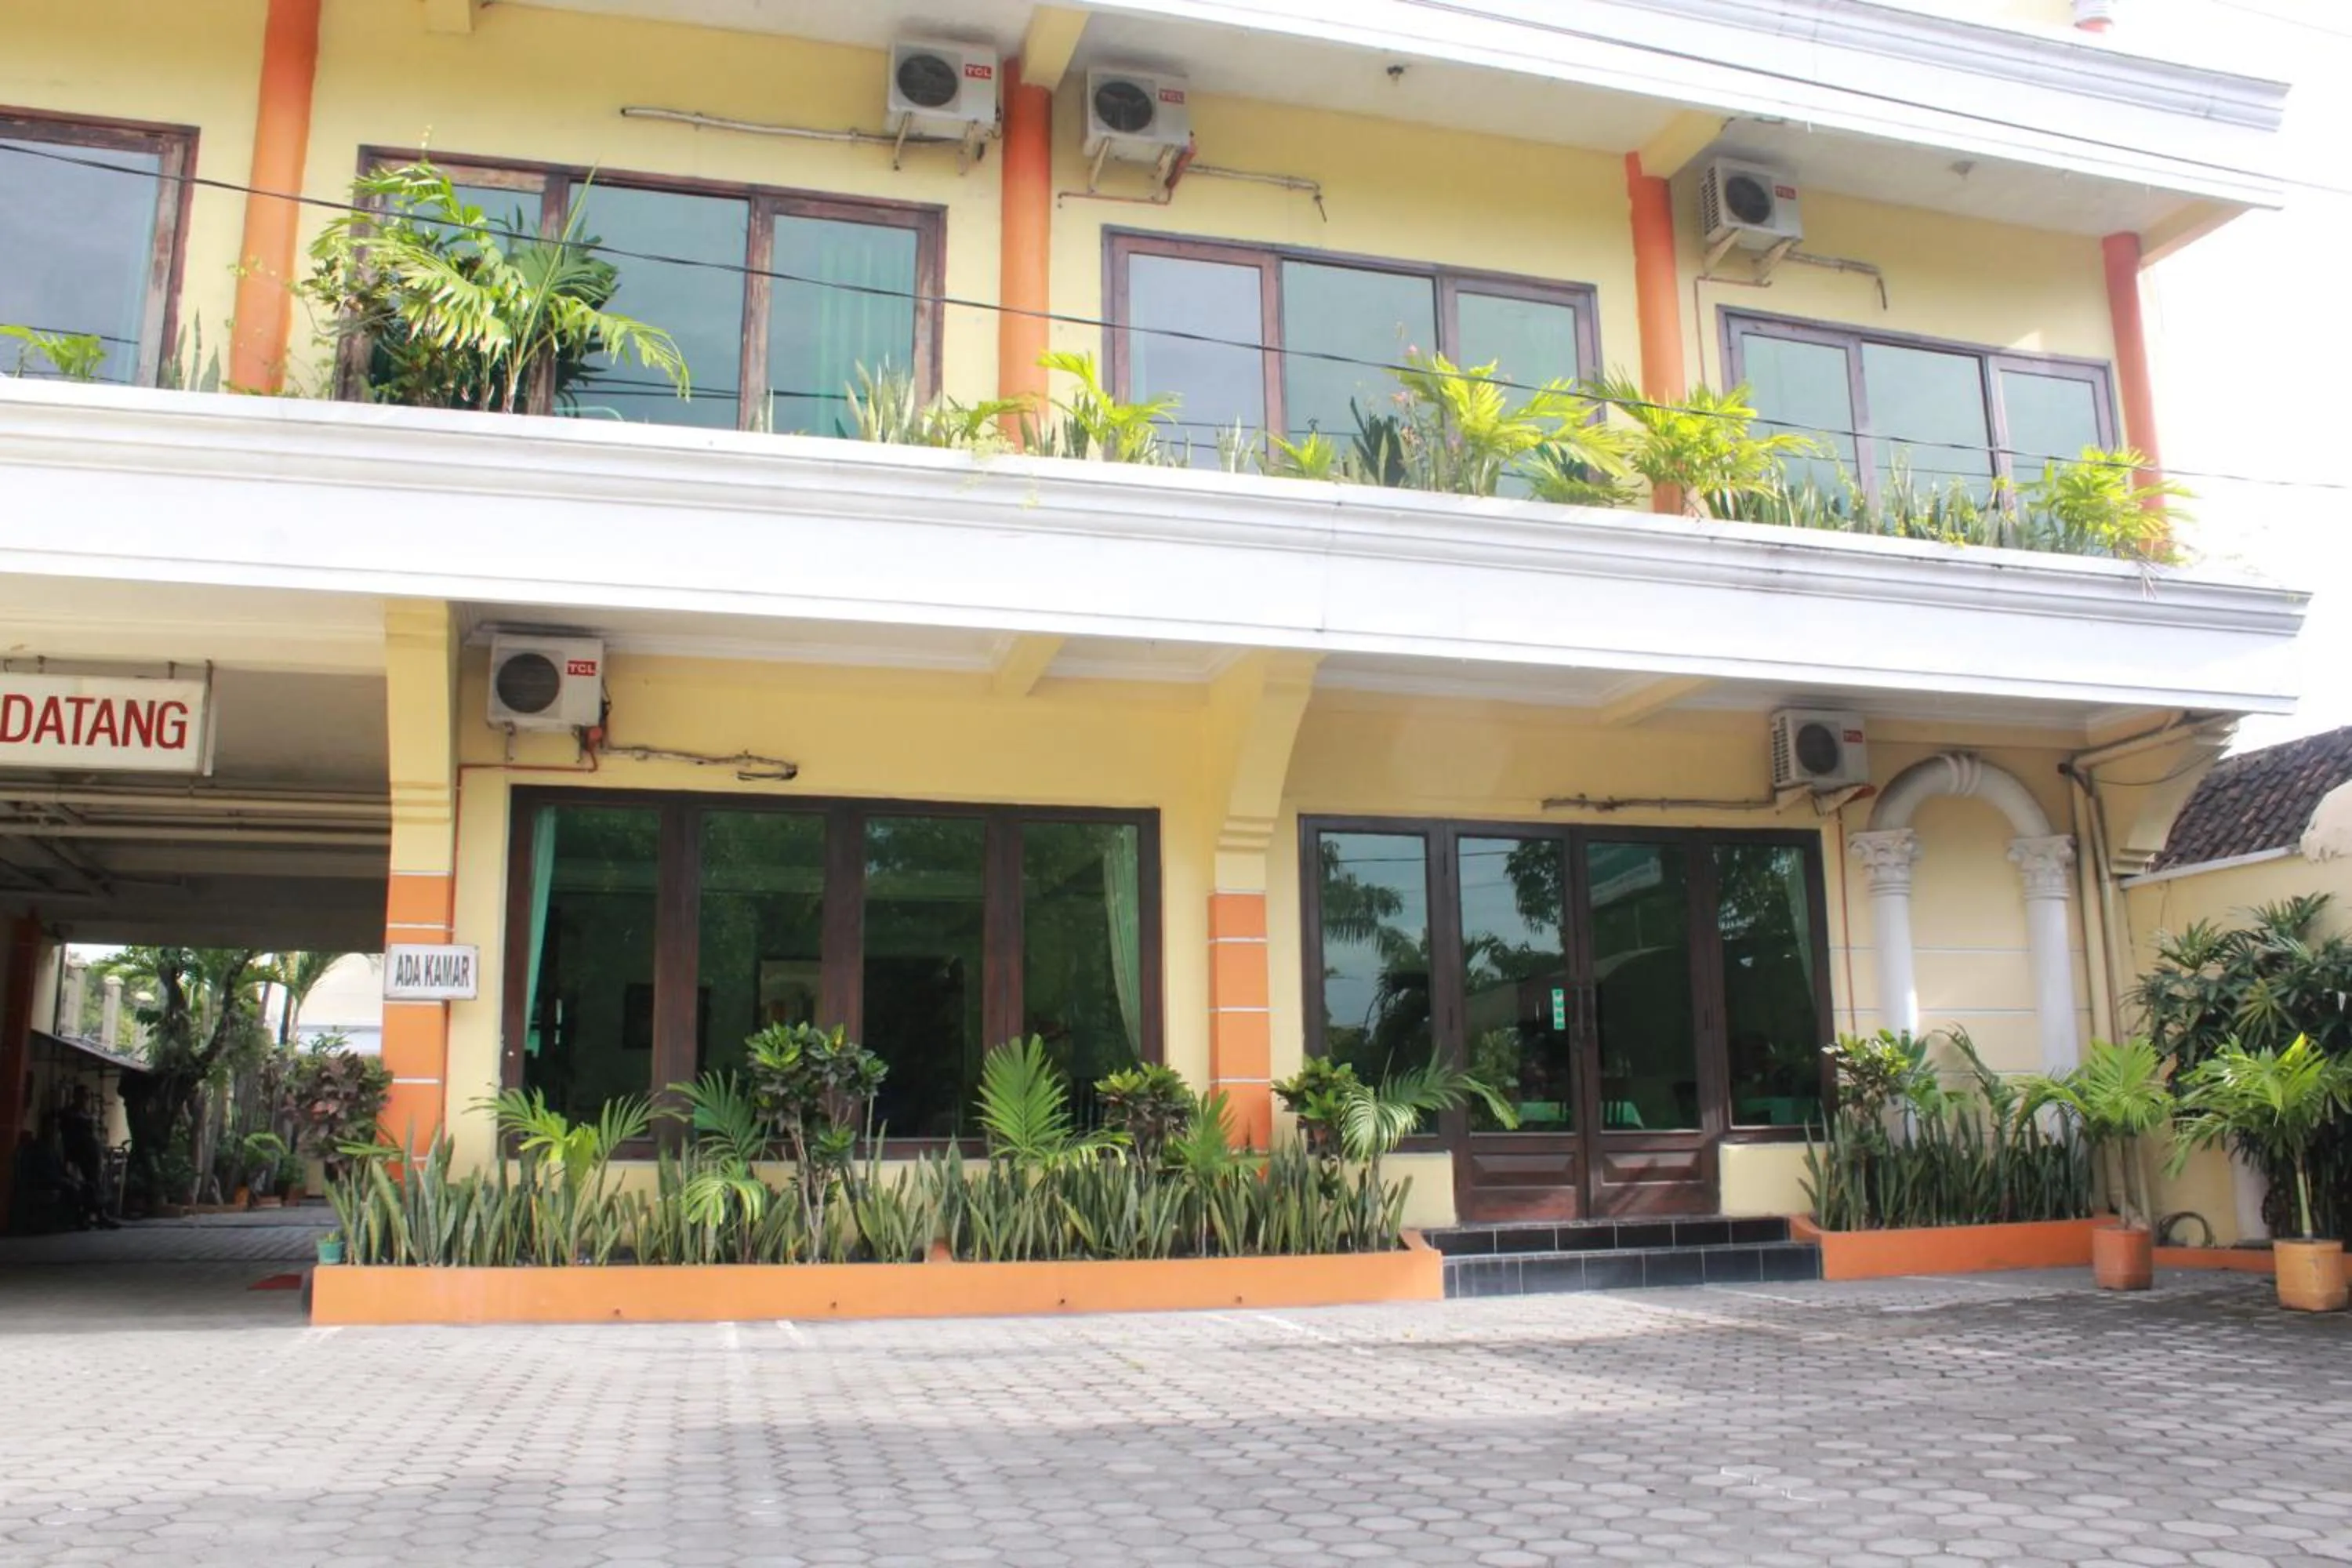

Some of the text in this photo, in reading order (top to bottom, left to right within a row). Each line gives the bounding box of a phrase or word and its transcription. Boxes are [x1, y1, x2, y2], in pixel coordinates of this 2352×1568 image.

[965, 65, 992, 78] TCL
[568, 662, 596, 675] TCL
[0, 694, 188, 750] DATANG
[394, 953, 470, 987] ADA KAMAR
